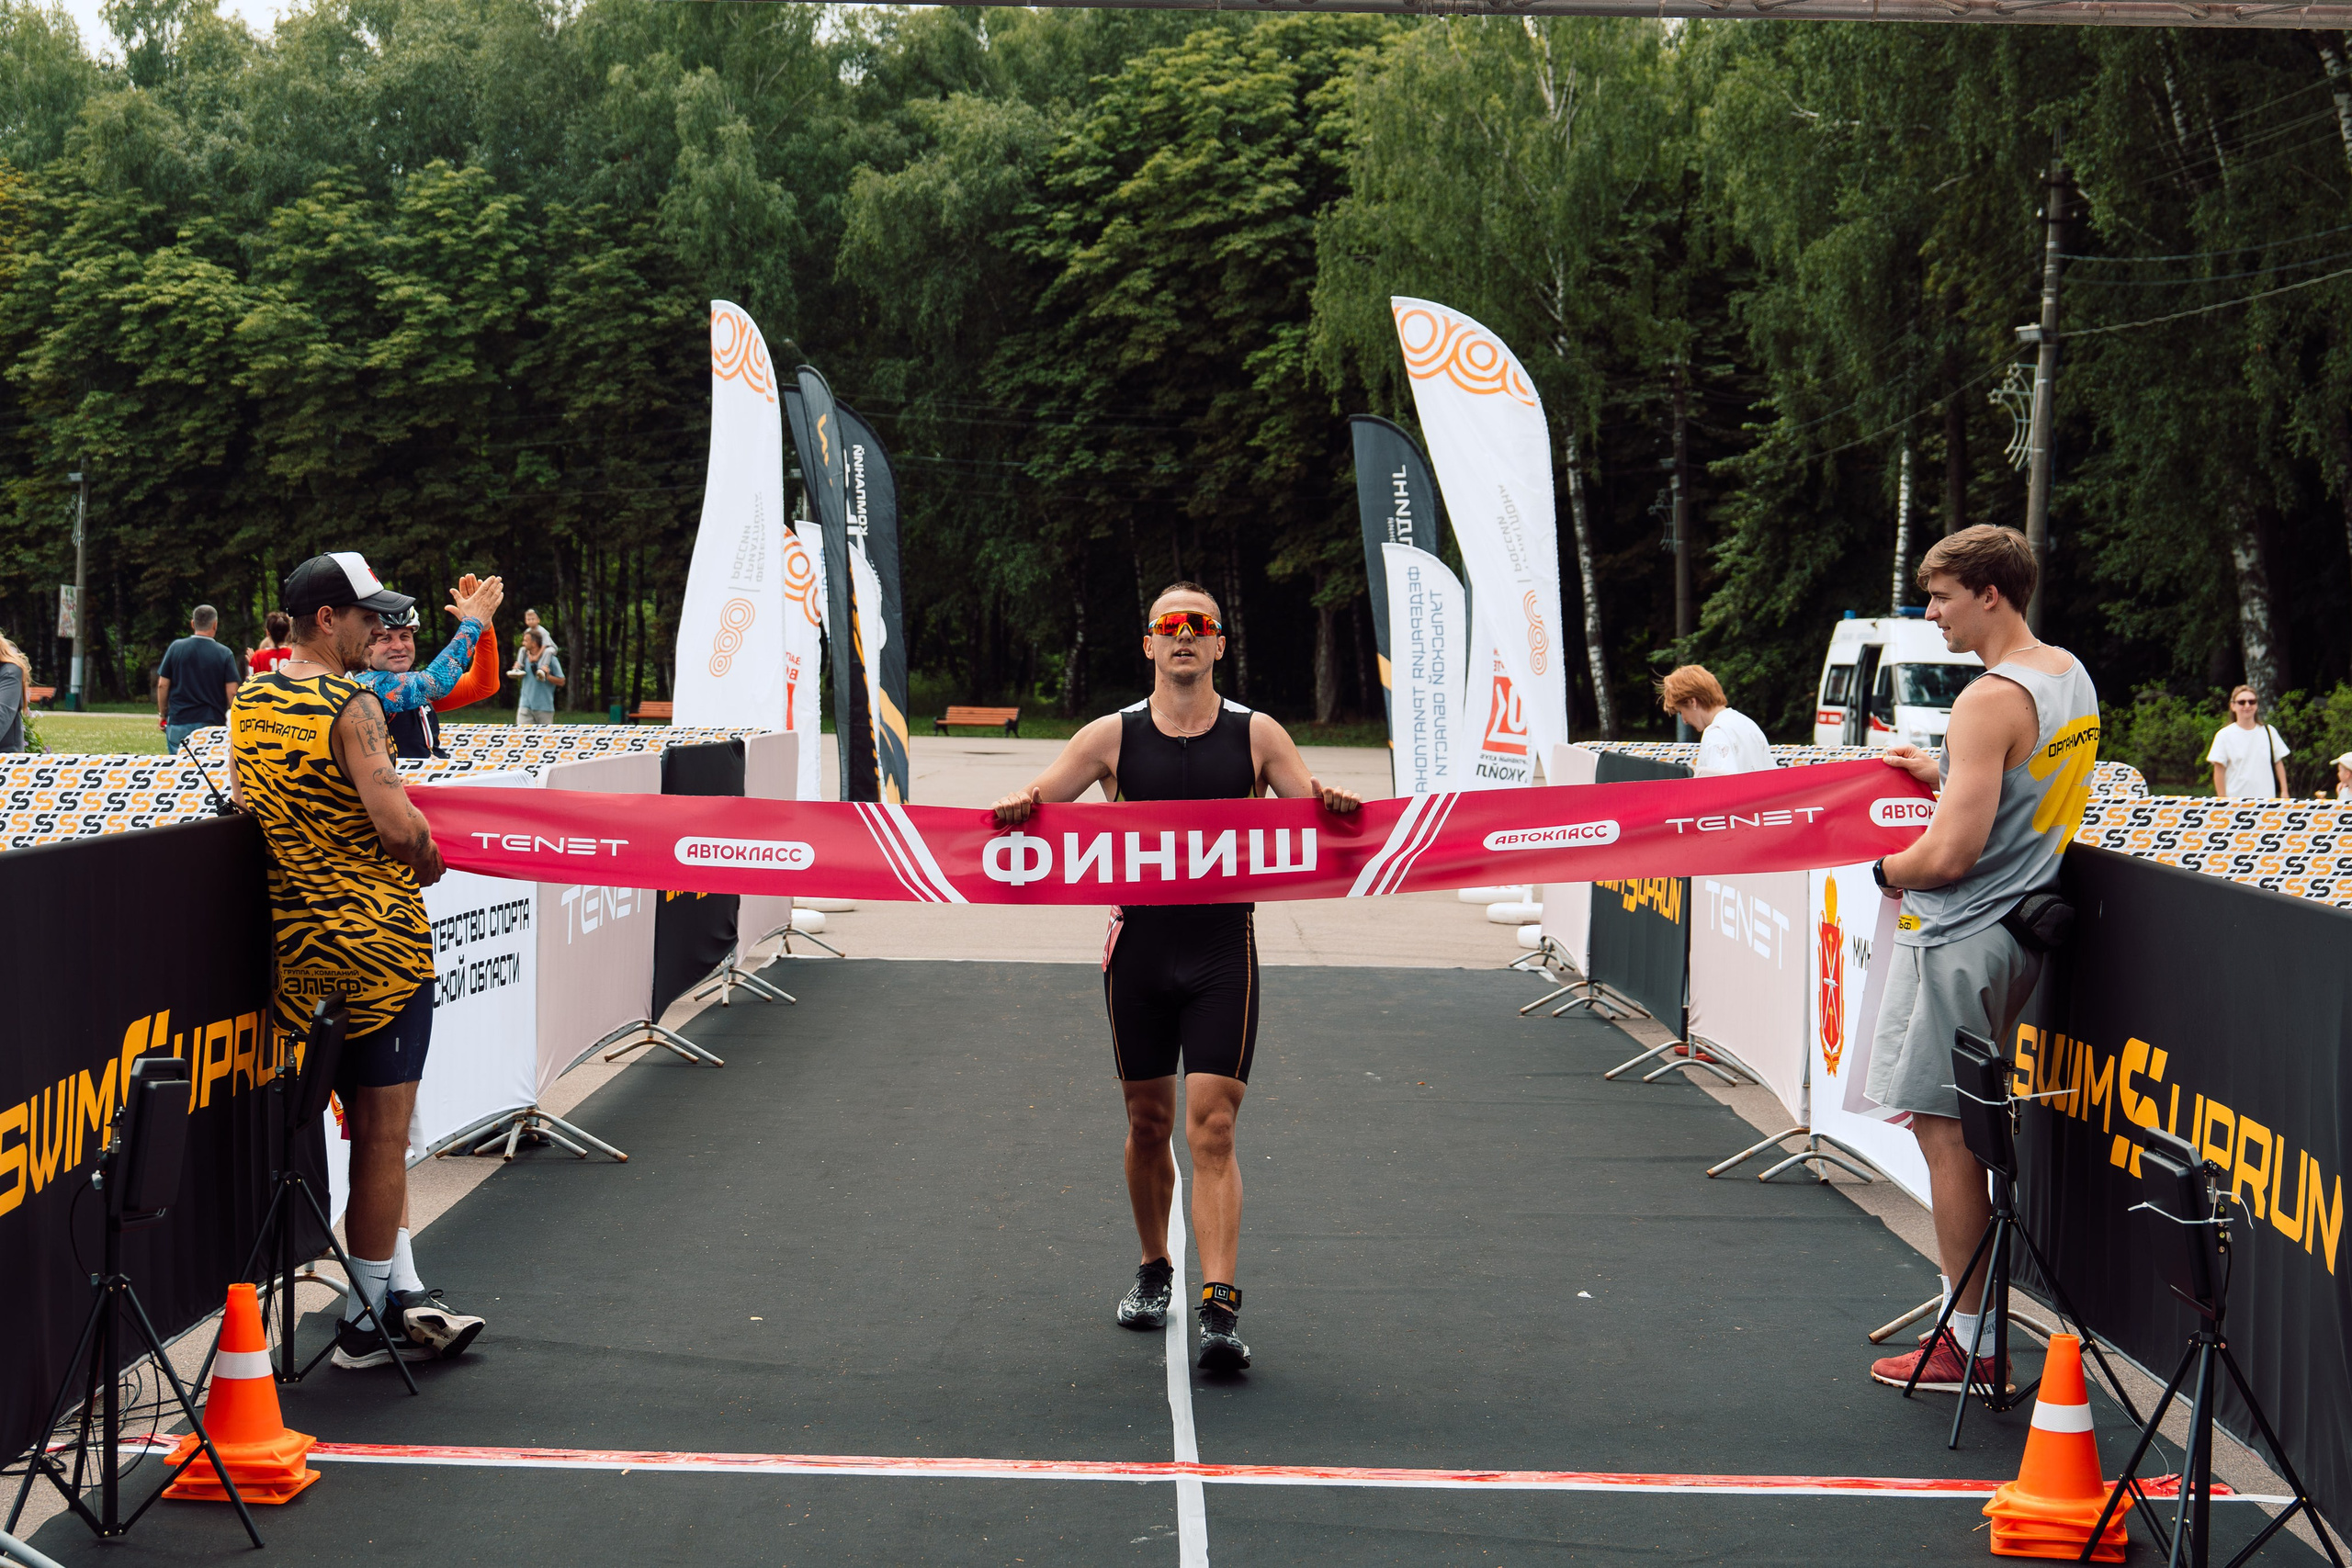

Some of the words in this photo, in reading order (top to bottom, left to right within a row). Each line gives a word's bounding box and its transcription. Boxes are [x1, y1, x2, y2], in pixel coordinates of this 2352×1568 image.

[1665, 807, 1824, 834] TENET
[1882, 804, 1936, 819] АВТОК
[470, 831, 629, 856] TENET
[1494, 825, 1608, 846] АВТОКЛАСС
[686, 843, 803, 863] АВТОКЛАСС
[982, 828, 1317, 886] ФИНИШ
[432, 908, 486, 955] ТЕРСТВО
[490, 897, 530, 938] СПОРТА
[1704, 879, 1790, 970] TENET
[283, 977, 362, 996] ЭЛЬФ
[433, 953, 466, 1010] СКОЙ
[469, 952, 521, 995] ОБЛАСТИ
